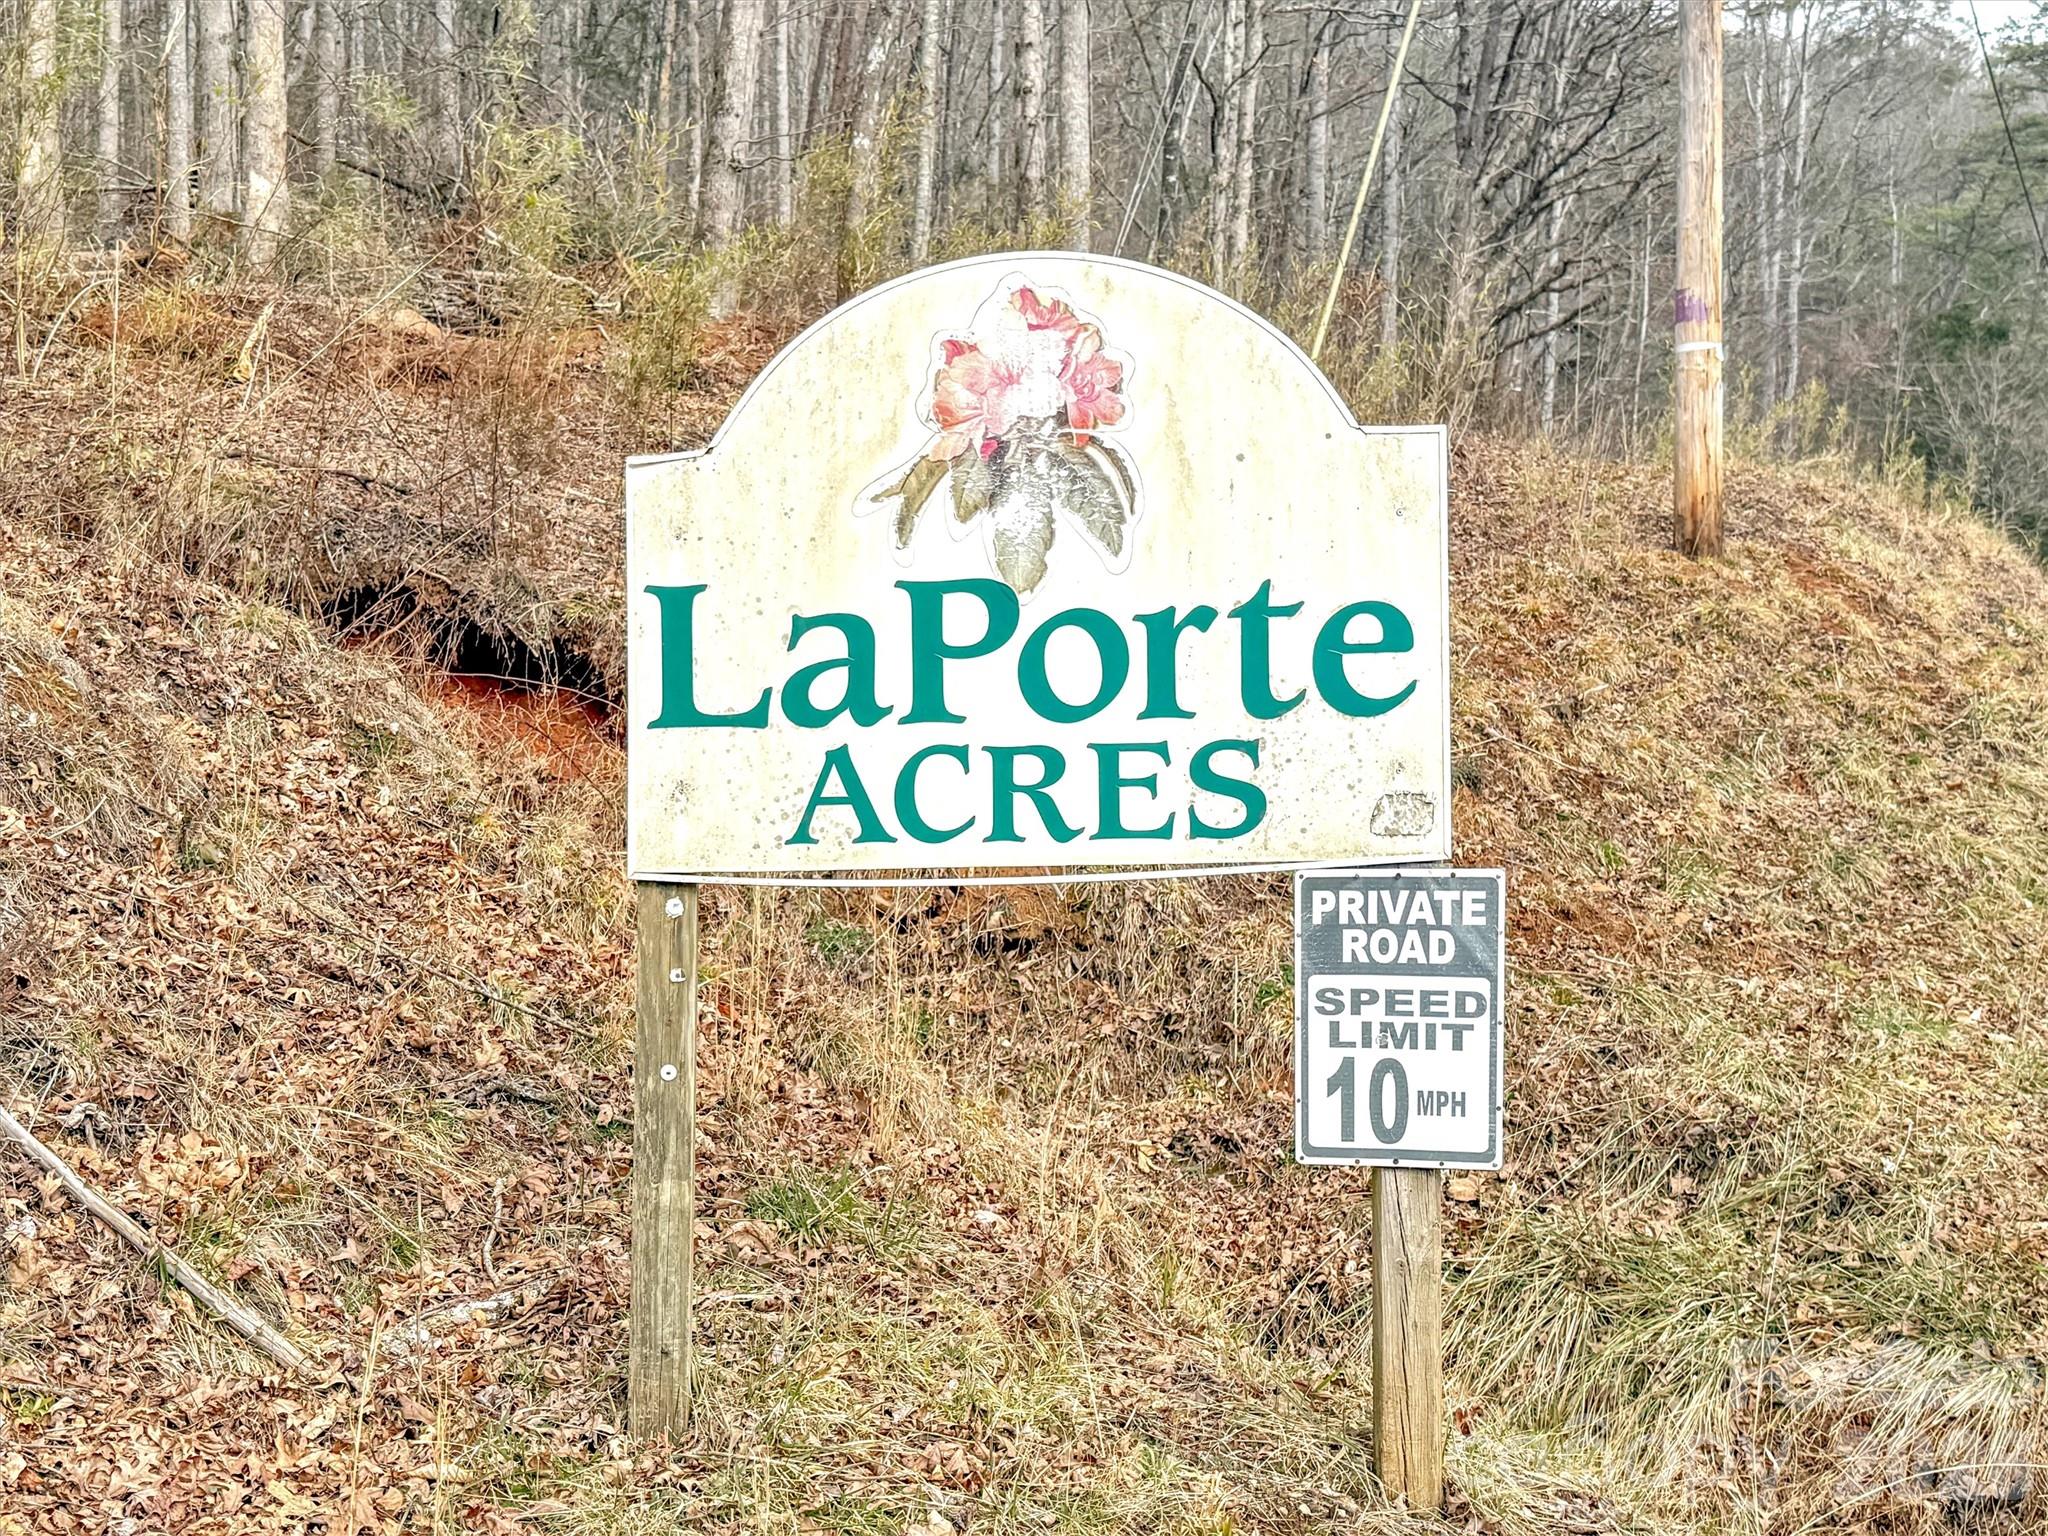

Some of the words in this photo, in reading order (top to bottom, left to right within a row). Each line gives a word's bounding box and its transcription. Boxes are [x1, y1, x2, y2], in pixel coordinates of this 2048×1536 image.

[645, 578, 1418, 729] LaPorte
[784, 739, 1269, 845] ACRES
[1311, 889, 1488, 926] PRIVATE
[1341, 928, 1456, 965] ROAD
[1314, 987, 1488, 1019] SPEED
[1328, 1020, 1476, 1052] LIMIT
[1326, 1056, 1410, 1145] 10
[1416, 1089, 1467, 1118] MPH
